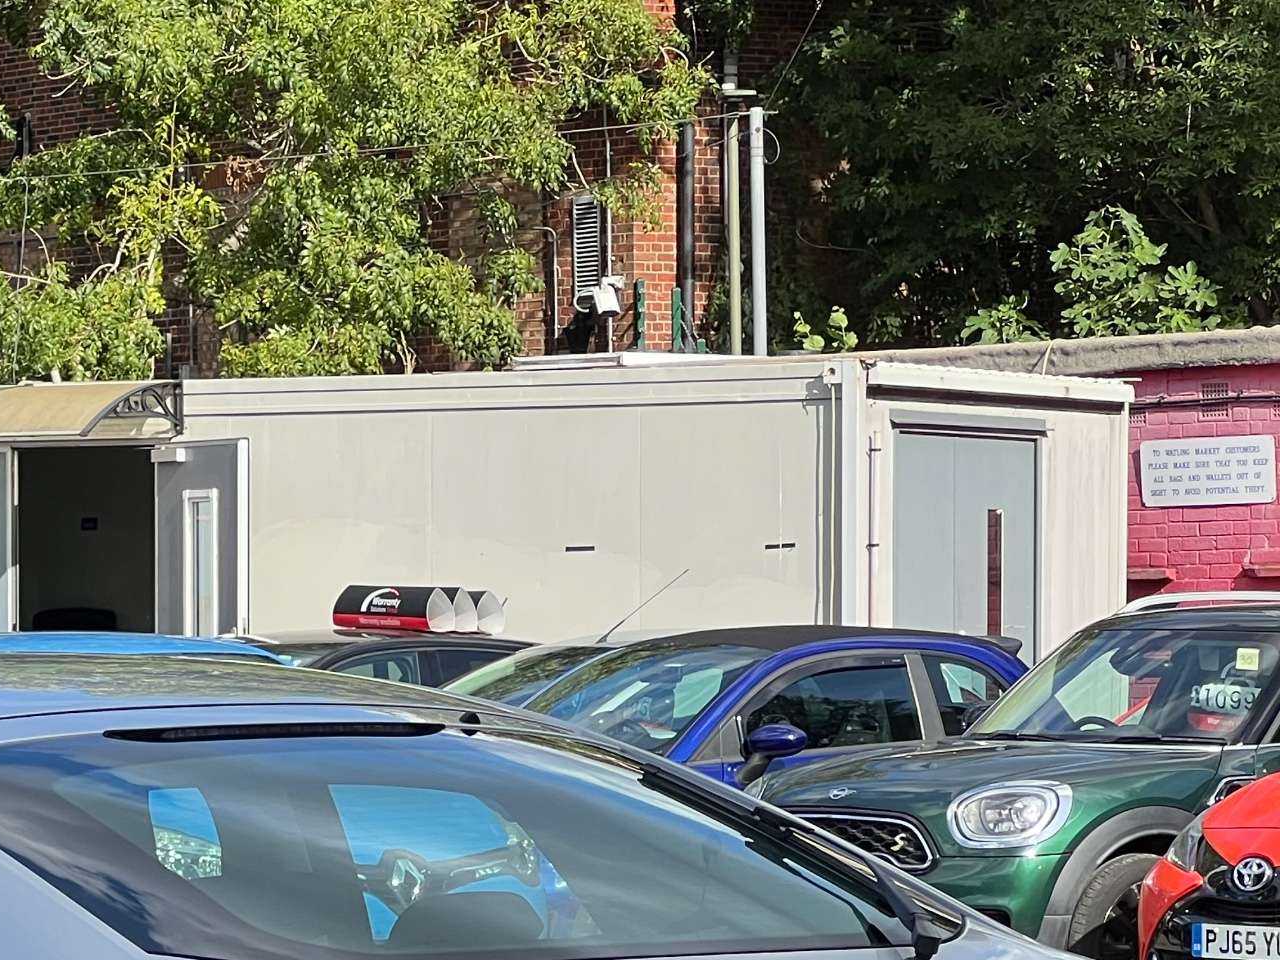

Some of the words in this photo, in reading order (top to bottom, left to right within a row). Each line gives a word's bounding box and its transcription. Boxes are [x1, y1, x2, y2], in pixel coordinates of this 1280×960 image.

[1152, 449, 1161, 457] TO
[1195, 447, 1220, 455] MARKET
[1148, 462, 1168, 470] PLEASE
[1173, 461, 1190, 469] MAKE
[1195, 460, 1210, 468] SURE
[1253, 458, 1269, 466] KEEP
[1153, 475, 1164, 483] ALL
[1206, 473, 1231, 481] WALLETS
[1236, 472, 1248, 480] OUT
[1253, 471, 1262, 479] OF
[1172, 488, 1180, 496] TO
[1184, 488, 1201, 496] AVOID
[1205, 486, 1240, 495] POTENTIAL
[1245, 485, 1265, 494] THEFT
[1205, 929, 1257, 955] PJ65
